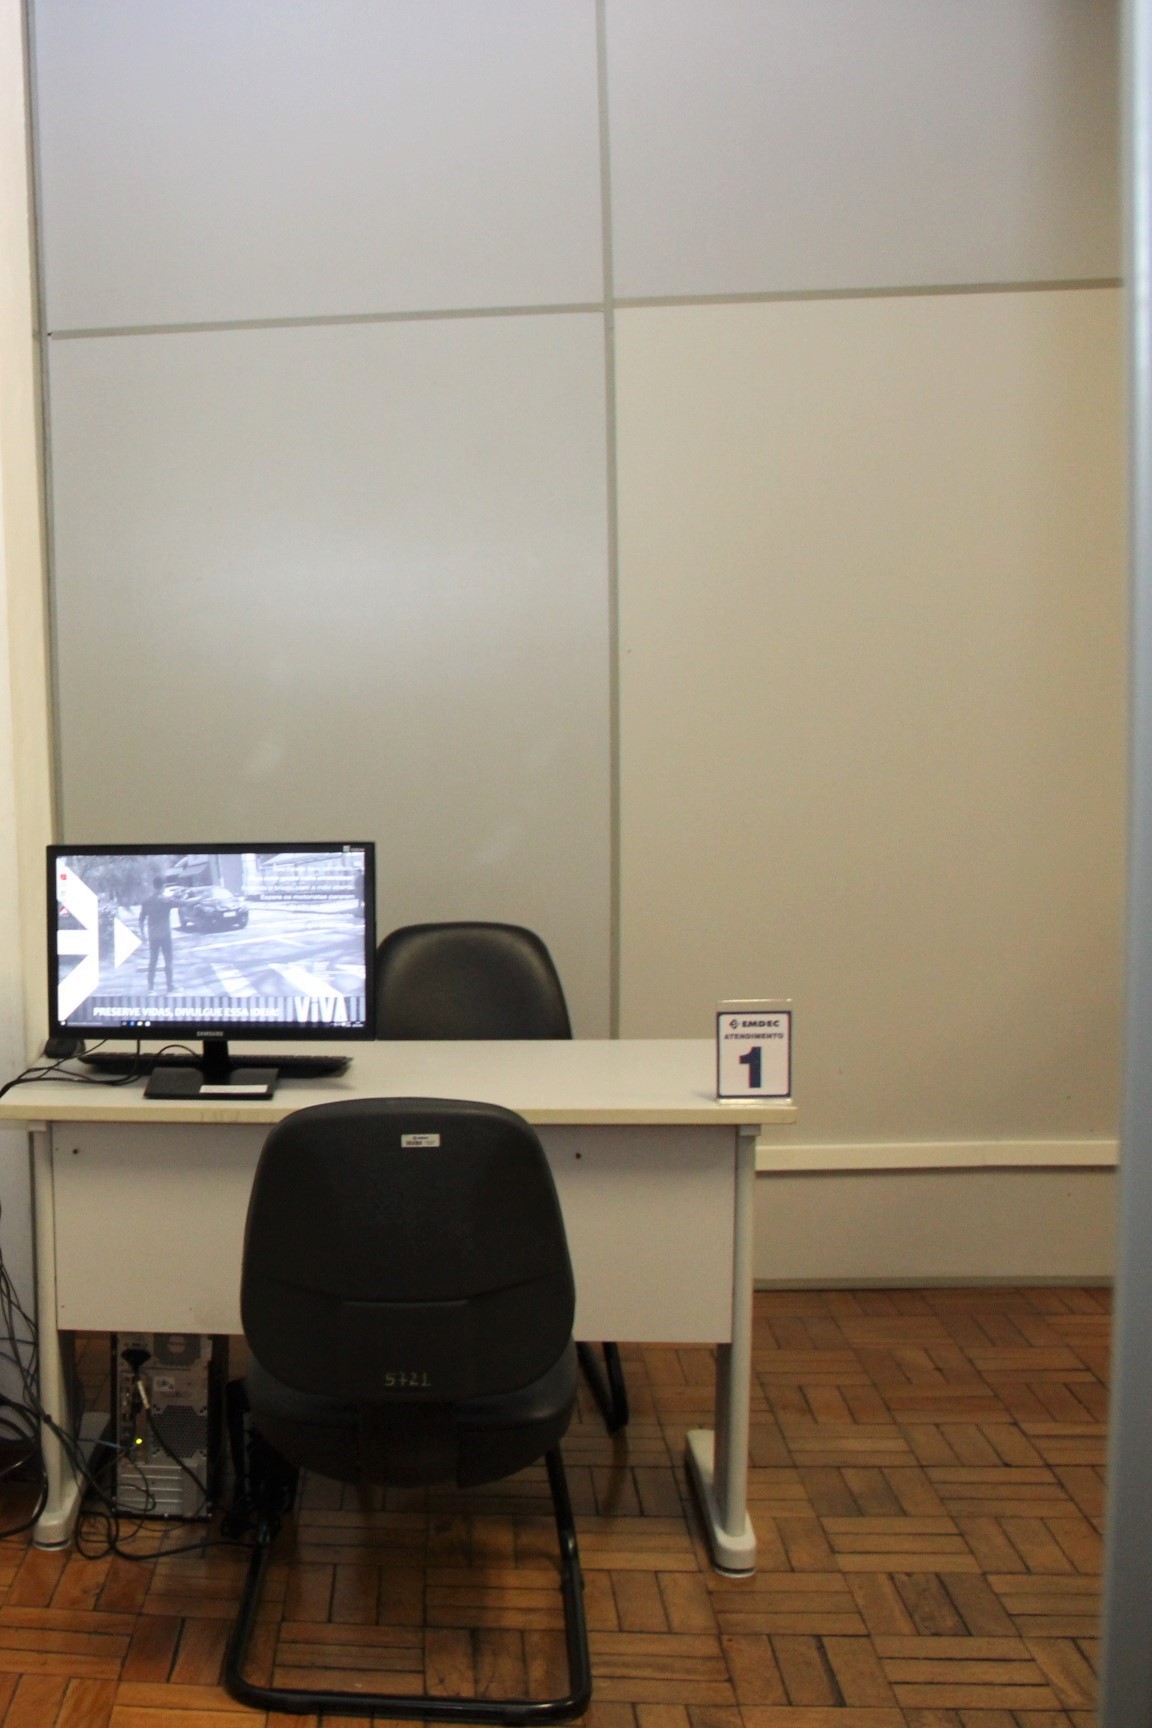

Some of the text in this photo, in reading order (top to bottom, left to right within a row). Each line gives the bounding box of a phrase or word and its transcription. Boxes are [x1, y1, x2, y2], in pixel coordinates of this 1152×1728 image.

[93, 1007, 141, 1017] PRESERVE
[141, 1007, 173, 1018] VIDAS,
[174, 1007, 223, 1017] DIVULGUE
[223, 1007, 249, 1017] ESSA
[741, 1020, 780, 1028] EMDEC
[739, 1046, 762, 1088] 1
